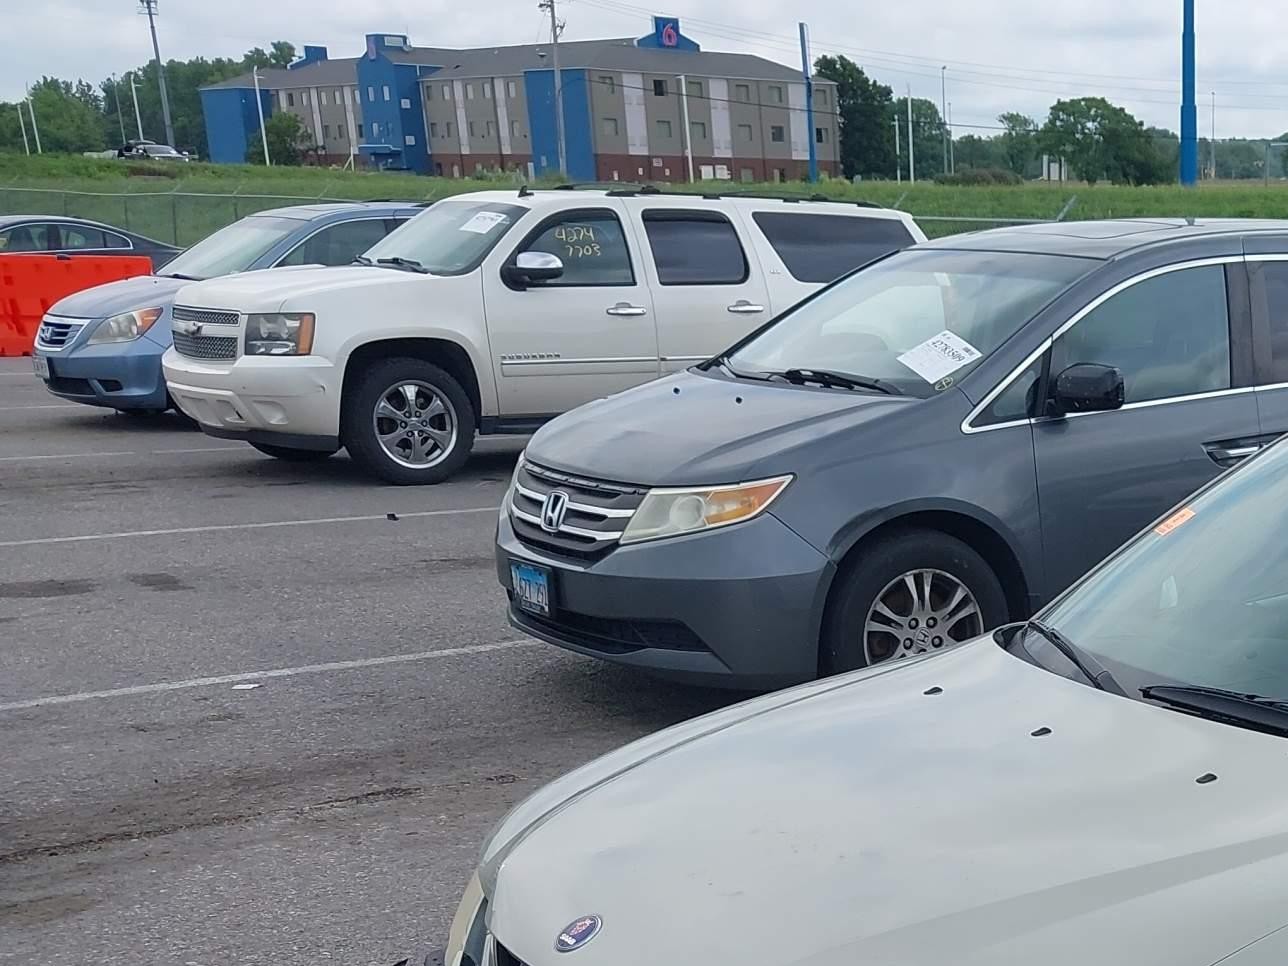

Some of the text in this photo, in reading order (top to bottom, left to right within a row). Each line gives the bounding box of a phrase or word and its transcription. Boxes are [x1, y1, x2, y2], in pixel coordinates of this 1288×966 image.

[662, 23, 678, 46] 6
[555, 226, 595, 242] 4274
[565, 243, 601, 257] 7703
